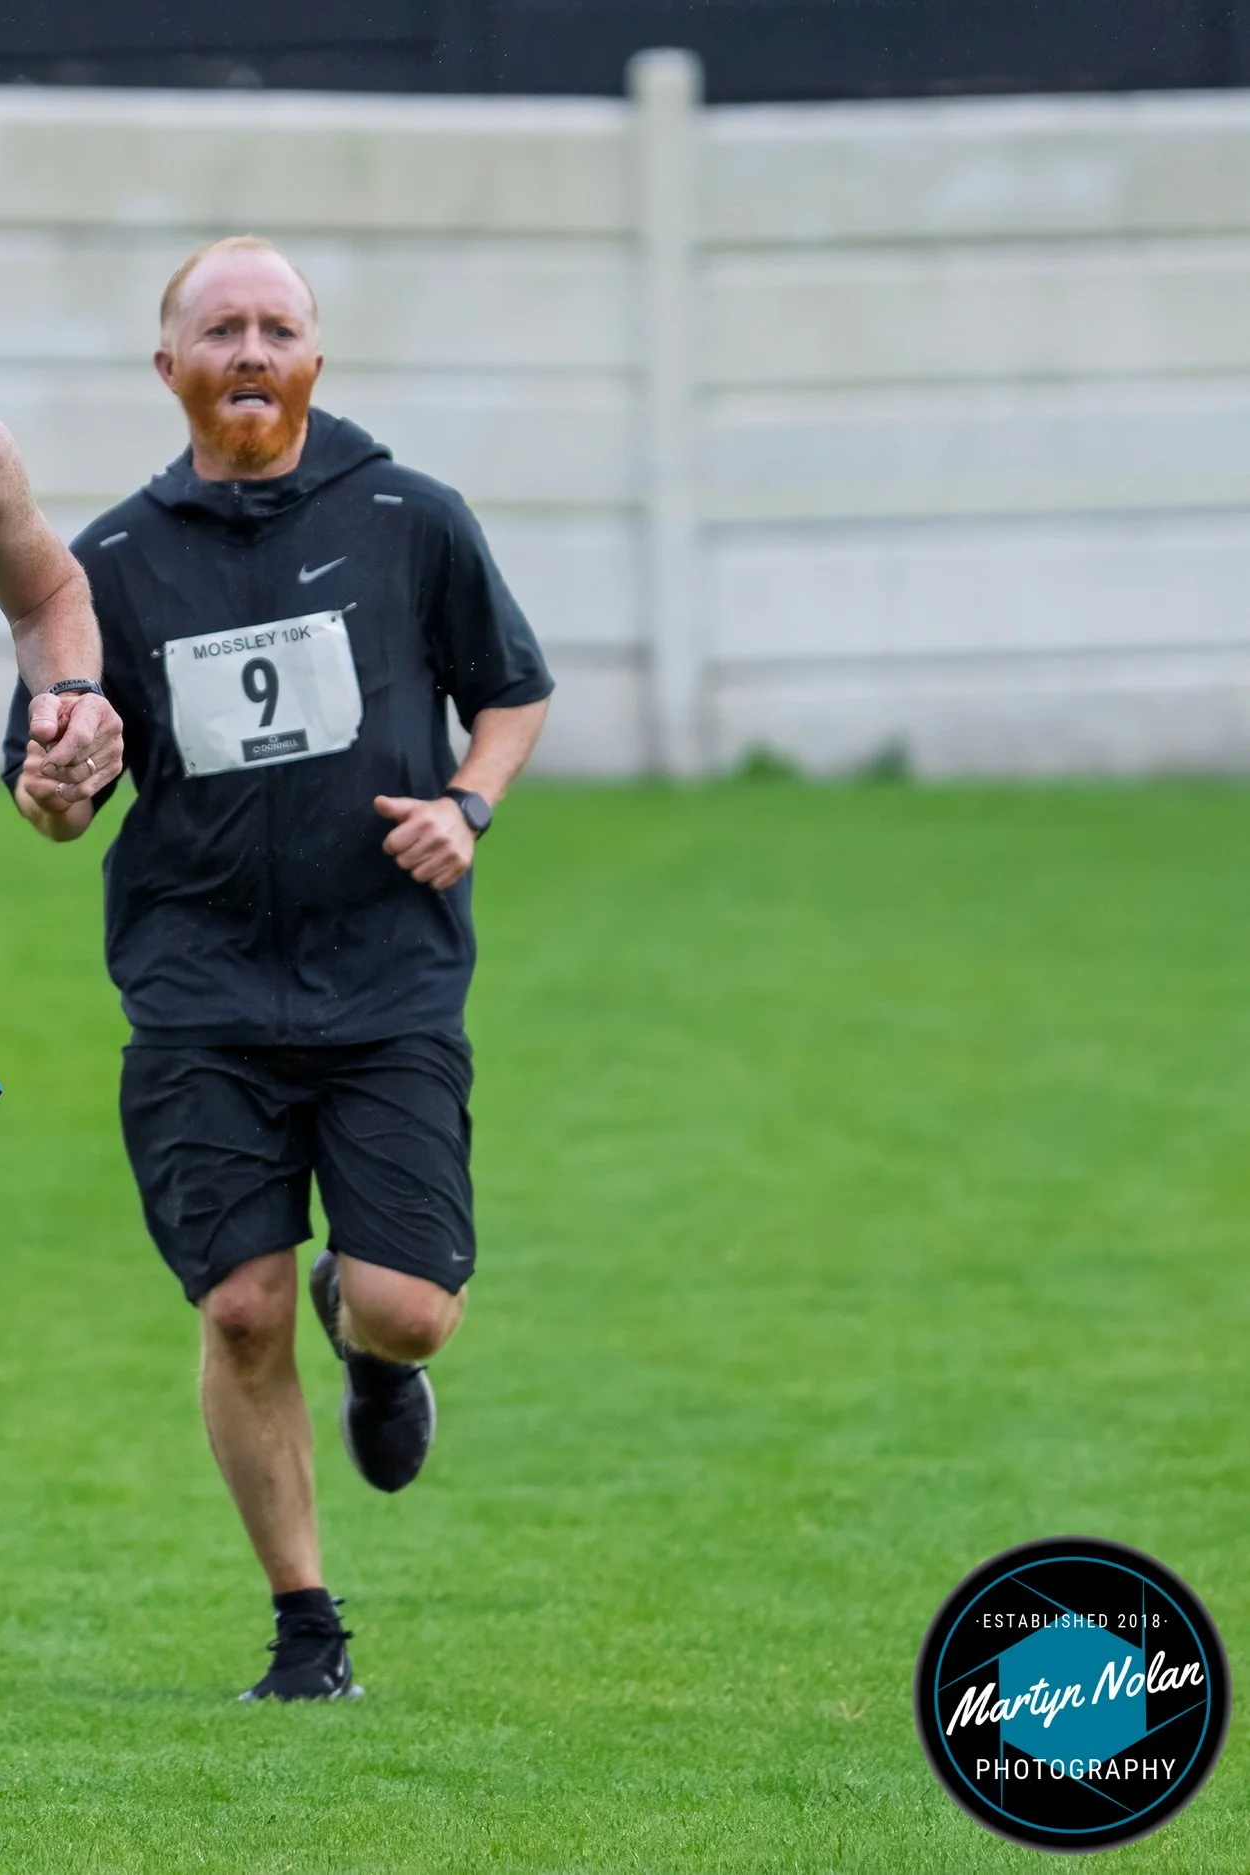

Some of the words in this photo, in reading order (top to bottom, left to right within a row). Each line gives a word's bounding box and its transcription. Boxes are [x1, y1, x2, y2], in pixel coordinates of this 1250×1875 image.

[193, 631, 277, 660] MOSSLEY
[282, 625, 312, 644] 10K
[241, 656, 280, 728] 9
